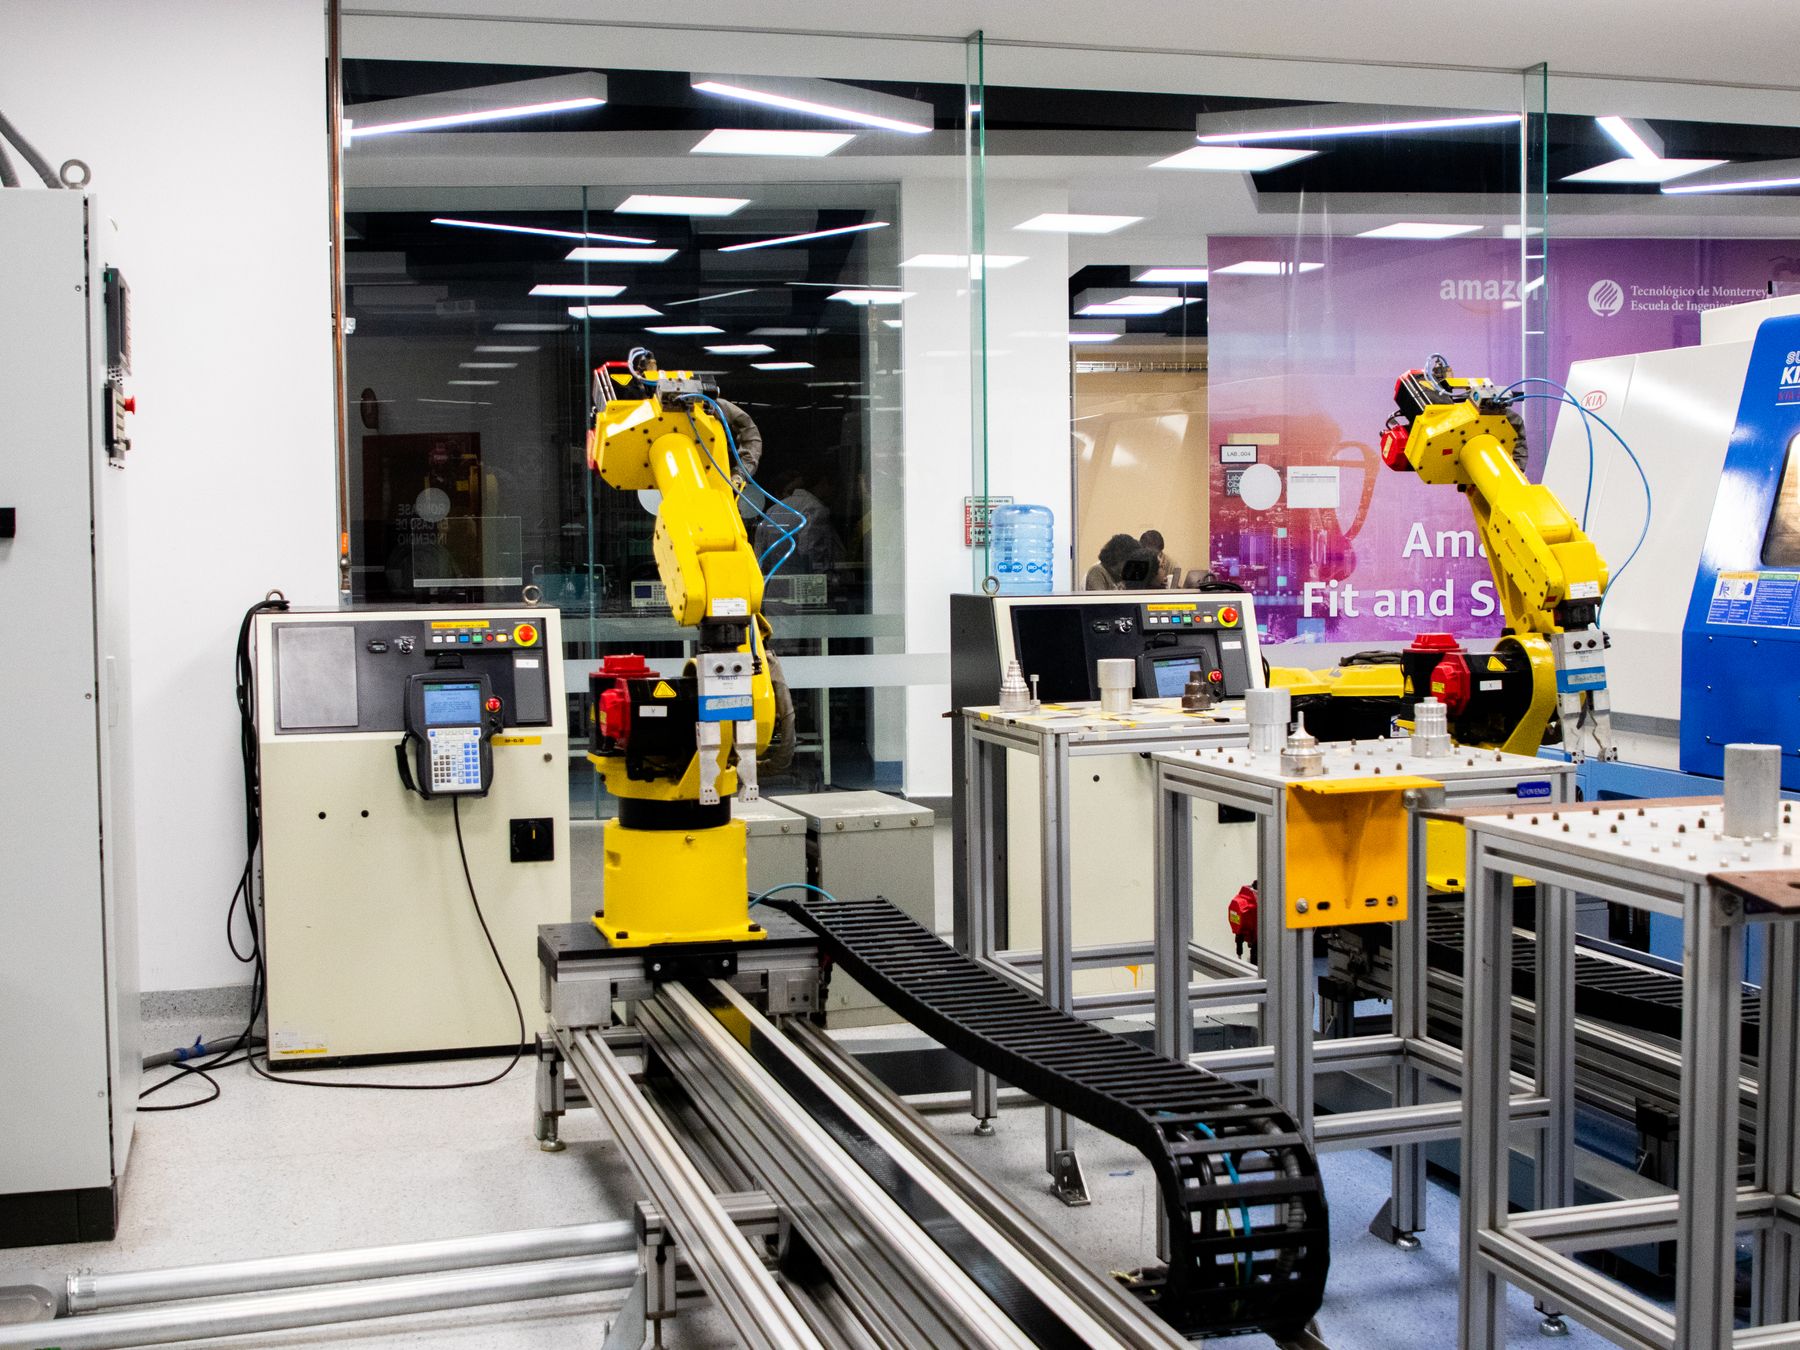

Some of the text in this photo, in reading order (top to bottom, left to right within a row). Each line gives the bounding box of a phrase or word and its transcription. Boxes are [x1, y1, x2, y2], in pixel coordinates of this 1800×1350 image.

[1630, 285, 1768, 299] Tecnológico de Monterrey
[1630, 300, 1669, 311] Escuela
[1671, 300, 1684, 311] de
[1780, 366, 1800, 385] KI
[1584, 395, 1603, 407] KIA
[1302, 579, 1505, 618] Fit and S
